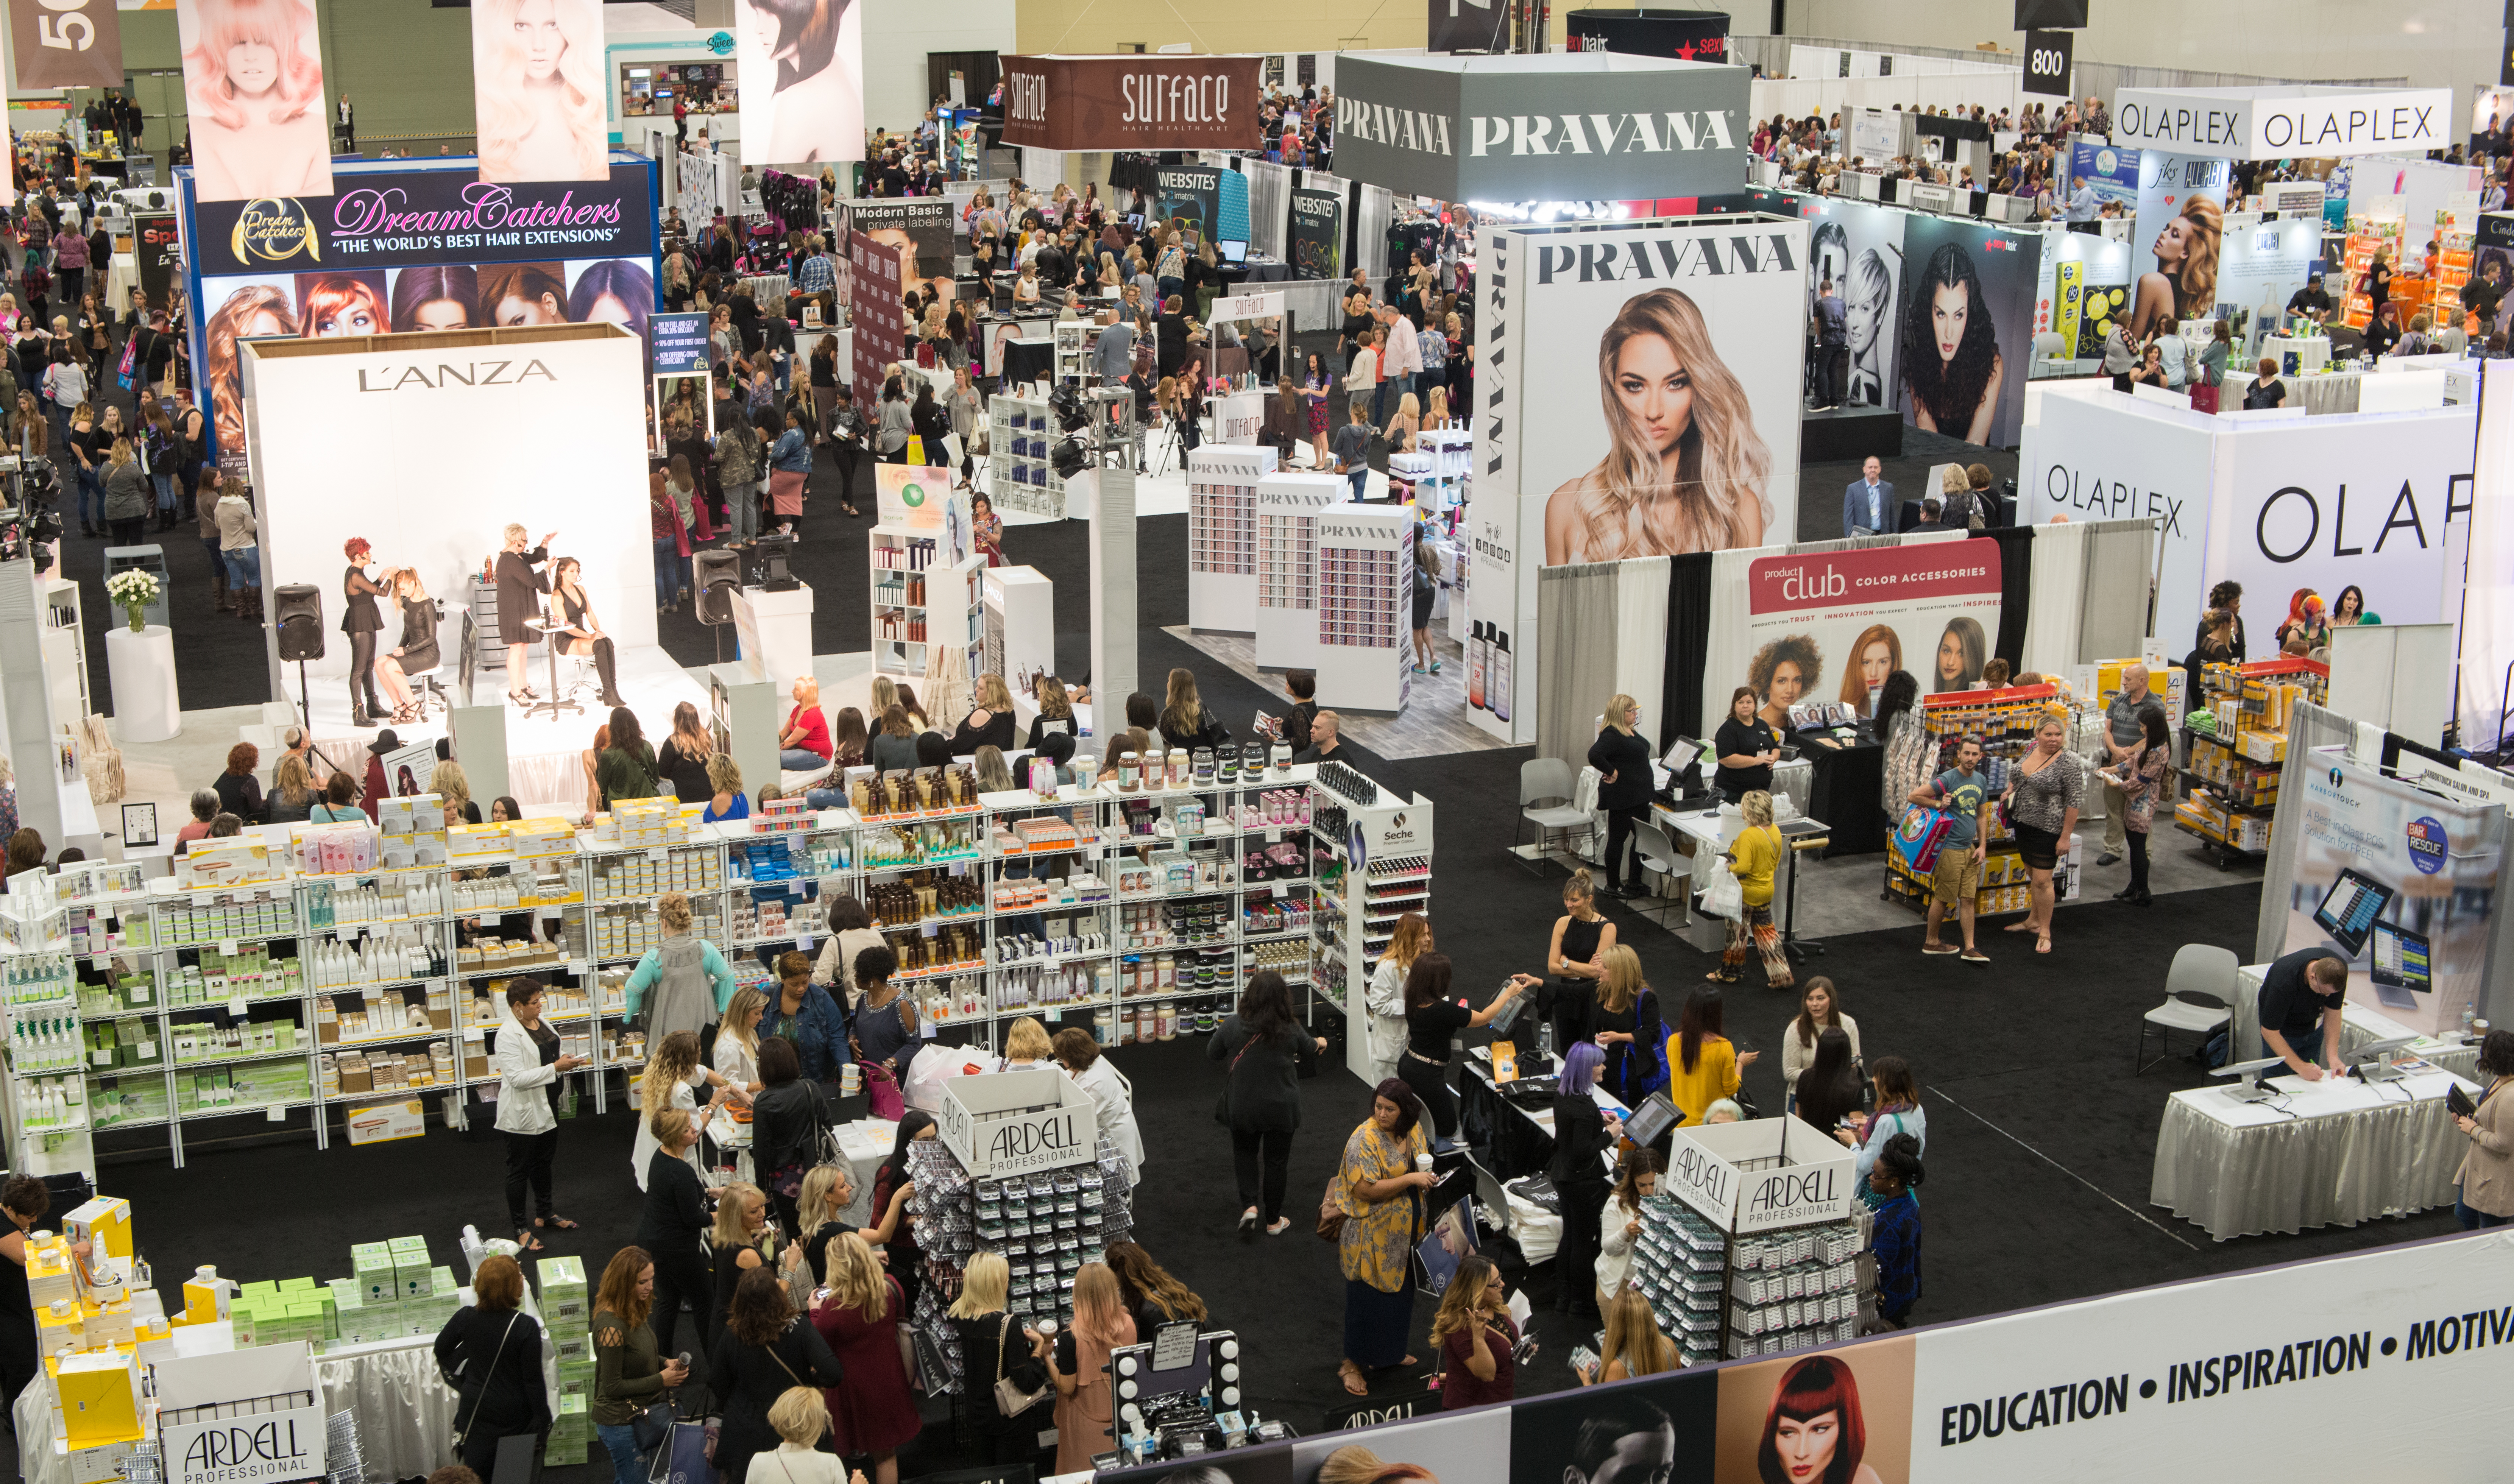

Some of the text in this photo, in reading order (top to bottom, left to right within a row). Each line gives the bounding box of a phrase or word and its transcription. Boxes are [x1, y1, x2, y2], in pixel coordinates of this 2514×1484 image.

[707, 37, 735, 51] Sweet
[1267, 57, 1283, 69] EXIT
[2031, 48, 2063, 76] 800
[1337, 97, 1452, 156] PRAVANA
[1469, 111, 1736, 156] PRAVANA
[2121, 103, 2238, 145] OLAPLEX
[2264, 106, 2433, 147] OLAPLEX
[1158, 171, 1216, 190] WEBSITES
[1159, 190, 1195, 201] by imatrix
[1293, 195, 1334, 218] WEBSITES
[246, 211, 295, 226] Dream
[856, 205, 943, 218] Modern Basic
[1295, 214, 1319, 227] by imatrix
[245, 223, 305, 239] Catchers
[868, 217, 951, 230] private labeling
[447, 233, 481, 248] BEST
[486, 232, 519, 246] HAIR
[1993, 238, 2018, 252] sexyhair
[1537, 234, 1797, 284] PRAVANA
[1487, 236, 1507, 477] PRAVANA
[1191, 463, 1259, 476] PRAVANA
[1260, 494, 1332, 507] PRAVANA
[1321, 525, 1397, 539] PRAVANA
[1485, 521, 1493, 540] Tag
[1480, 555, 1505, 572] #PRAVANA
[1764, 567, 1798, 581] product
[1783, 564, 1845, 600] club
[1856, 567, 1986, 587] COLOR ACCESSORIES
[1825, 610, 1874, 619] INNOVATION
[1474, 669, 1480, 680] 5R
[2166, 678, 2180, 721] station
[2424, 768, 2490, 800] HARBORTOUCH SALON AND SPA
[2310, 783, 2360, 808] HARBORTOUCH
[1385, 831, 1413, 840] Seche
[2306, 809, 2383, 848] A Best-in-Class POS
[2409, 823, 2425, 837] BAR
[1916, 823, 1943, 868] SalonCentric.com
[2305, 824, 2374, 861] Solution for FREE!
[2410, 838, 2441, 856] RESCUE
[943, 1096, 968, 1154] ARDELL
[990, 1114, 1081, 1161] ARDELL
[990, 1147, 1082, 1173] PROFESSIONAL
[1675, 1147, 1727, 1207] ARDELL
[1673, 1178, 1724, 1220] PROFESSIONAL
[1751, 1169, 1839, 1212] ARDELL
[1748, 1202, 1838, 1224] PROFESSIONAL
[1941, 1306, 2514, 1447] EDUCATION INSPIRATION MOTIV
[185, 1419, 307, 1472] ARDELL
[185, 1458, 308, 1484] PROFESSIONAL
